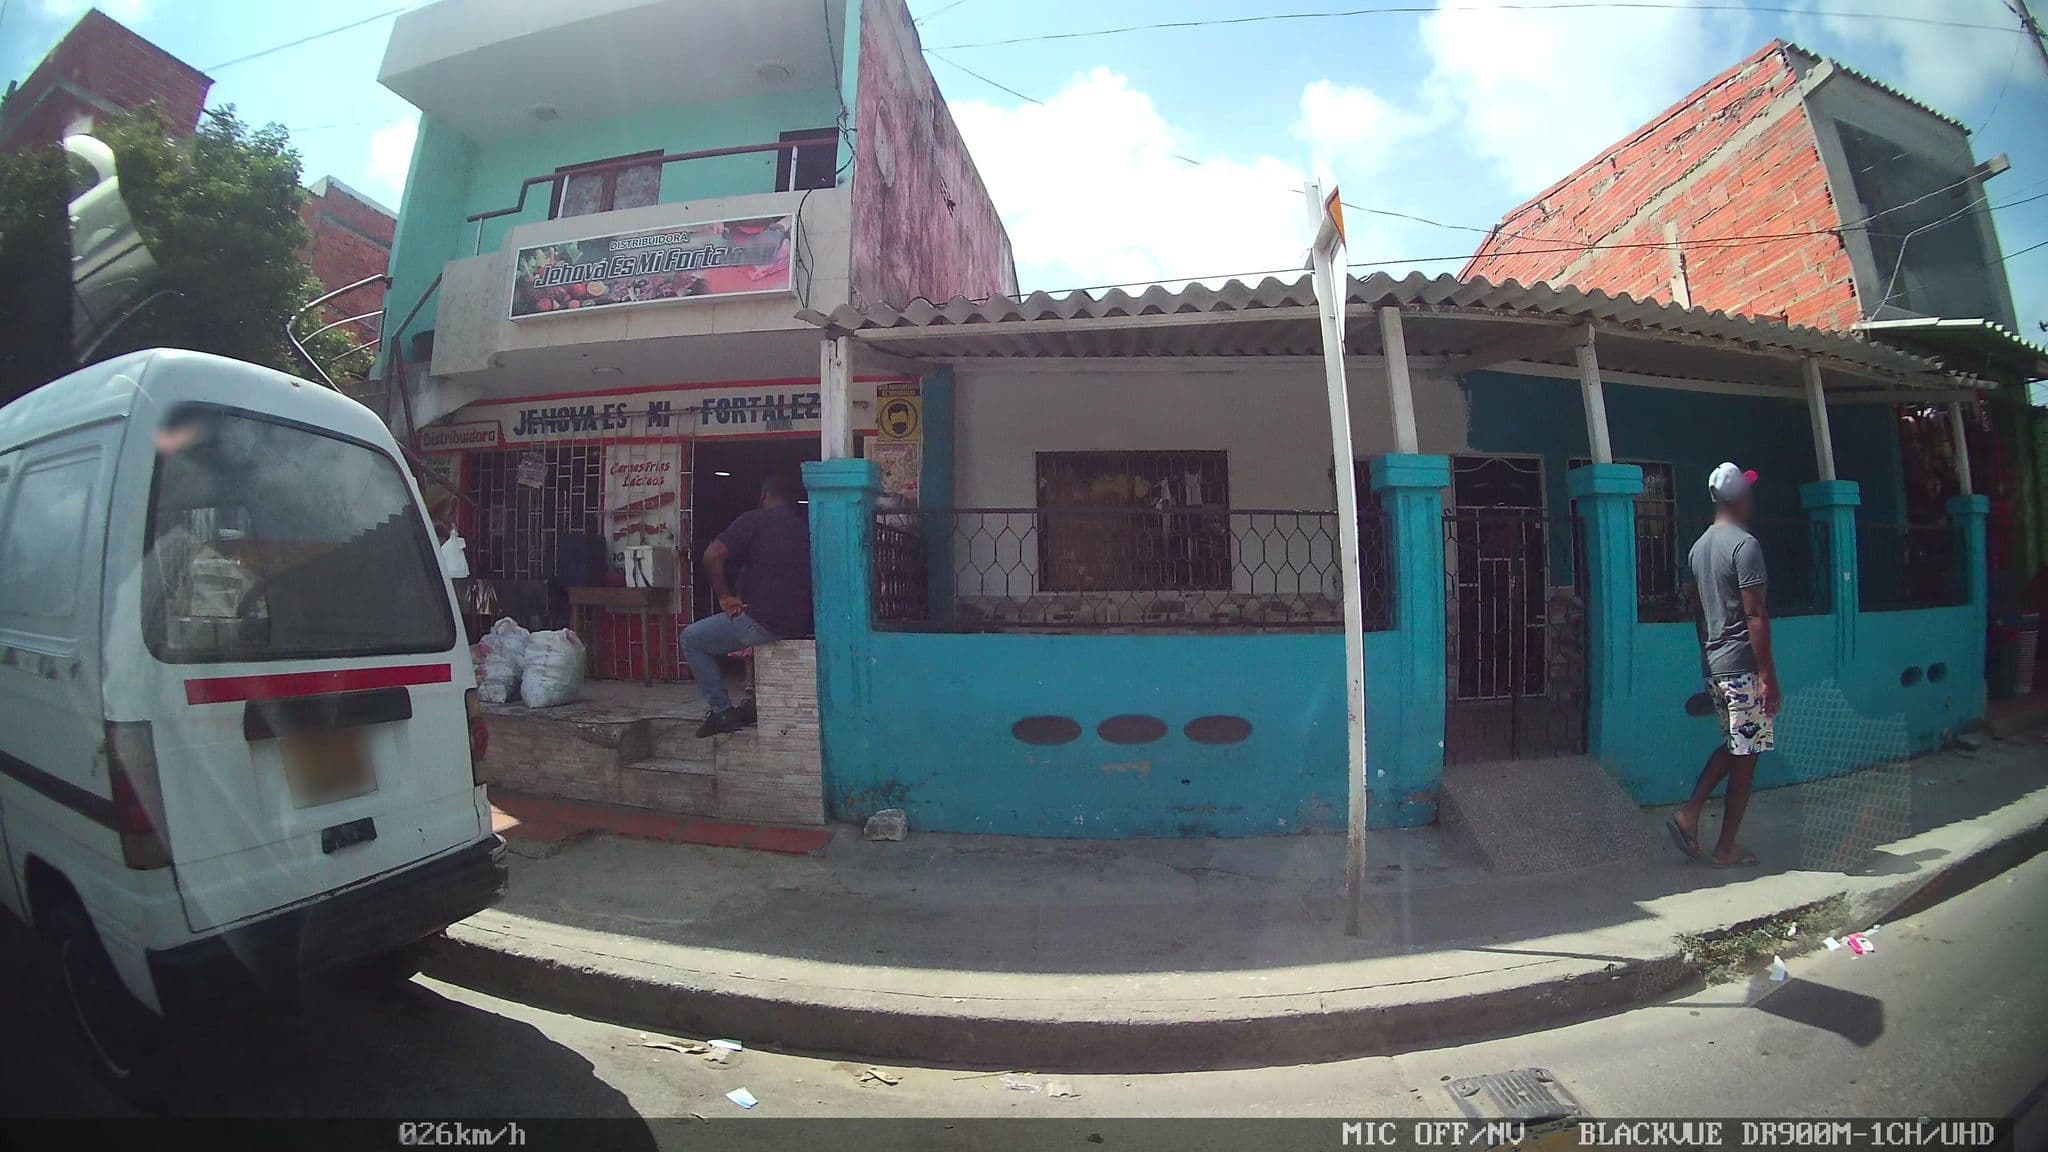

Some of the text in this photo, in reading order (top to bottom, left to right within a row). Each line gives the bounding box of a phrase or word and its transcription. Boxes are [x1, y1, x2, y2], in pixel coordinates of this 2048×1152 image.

[609, 232, 689, 250] DISTRIBUIDORA
[607, 250, 636, 279] Es
[635, 248, 663, 276] Mi
[513, 392, 822, 436] JEHOVA ES MI FORTALEZ
